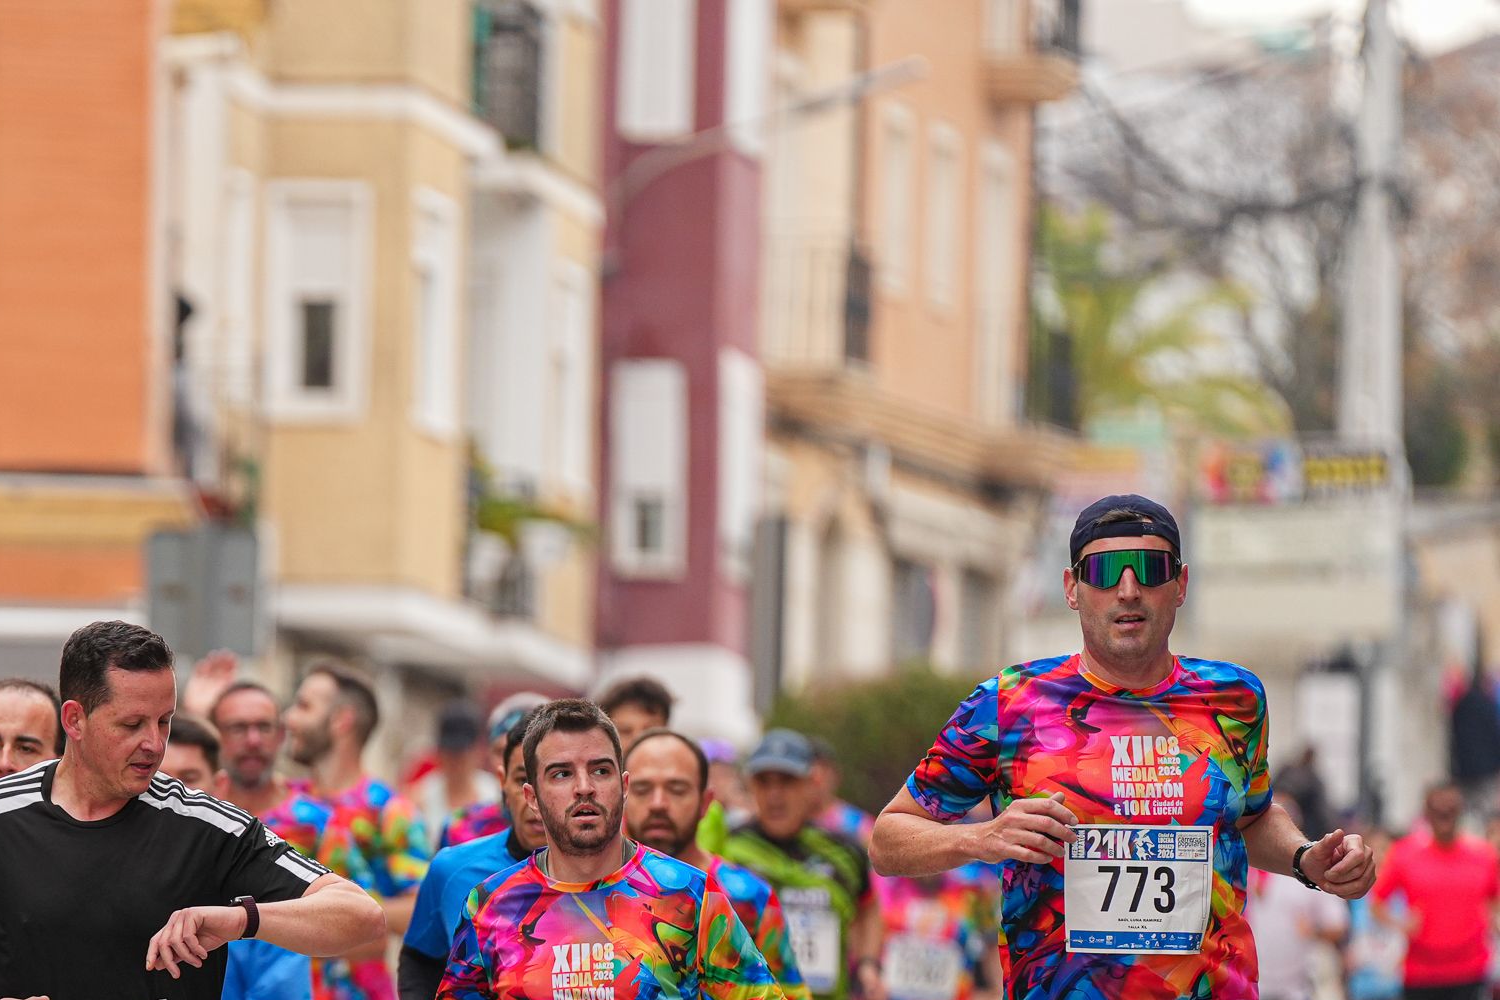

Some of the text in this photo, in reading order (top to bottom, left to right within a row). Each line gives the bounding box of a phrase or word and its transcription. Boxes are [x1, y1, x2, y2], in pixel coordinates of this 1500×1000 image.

[1110, 735, 1181, 767] XII 08
[1157, 757, 1181, 765] MARZO
[1111, 766, 1182, 783] MEDIA 2026
[1112, 778, 1184, 798] MARATÓN
[1122, 799, 1152, 816] 10K
[1152, 799, 1175, 807] Ciudad
[1153, 806, 1183, 816] LUCENA
[1086, 829, 1132, 859] 21K
[1157, 849, 1175, 859] 2026
[1098, 866, 1176, 914] 773
[551, 942, 615, 973] XII 08
[551, 970, 615, 989] MEDIA 2026
